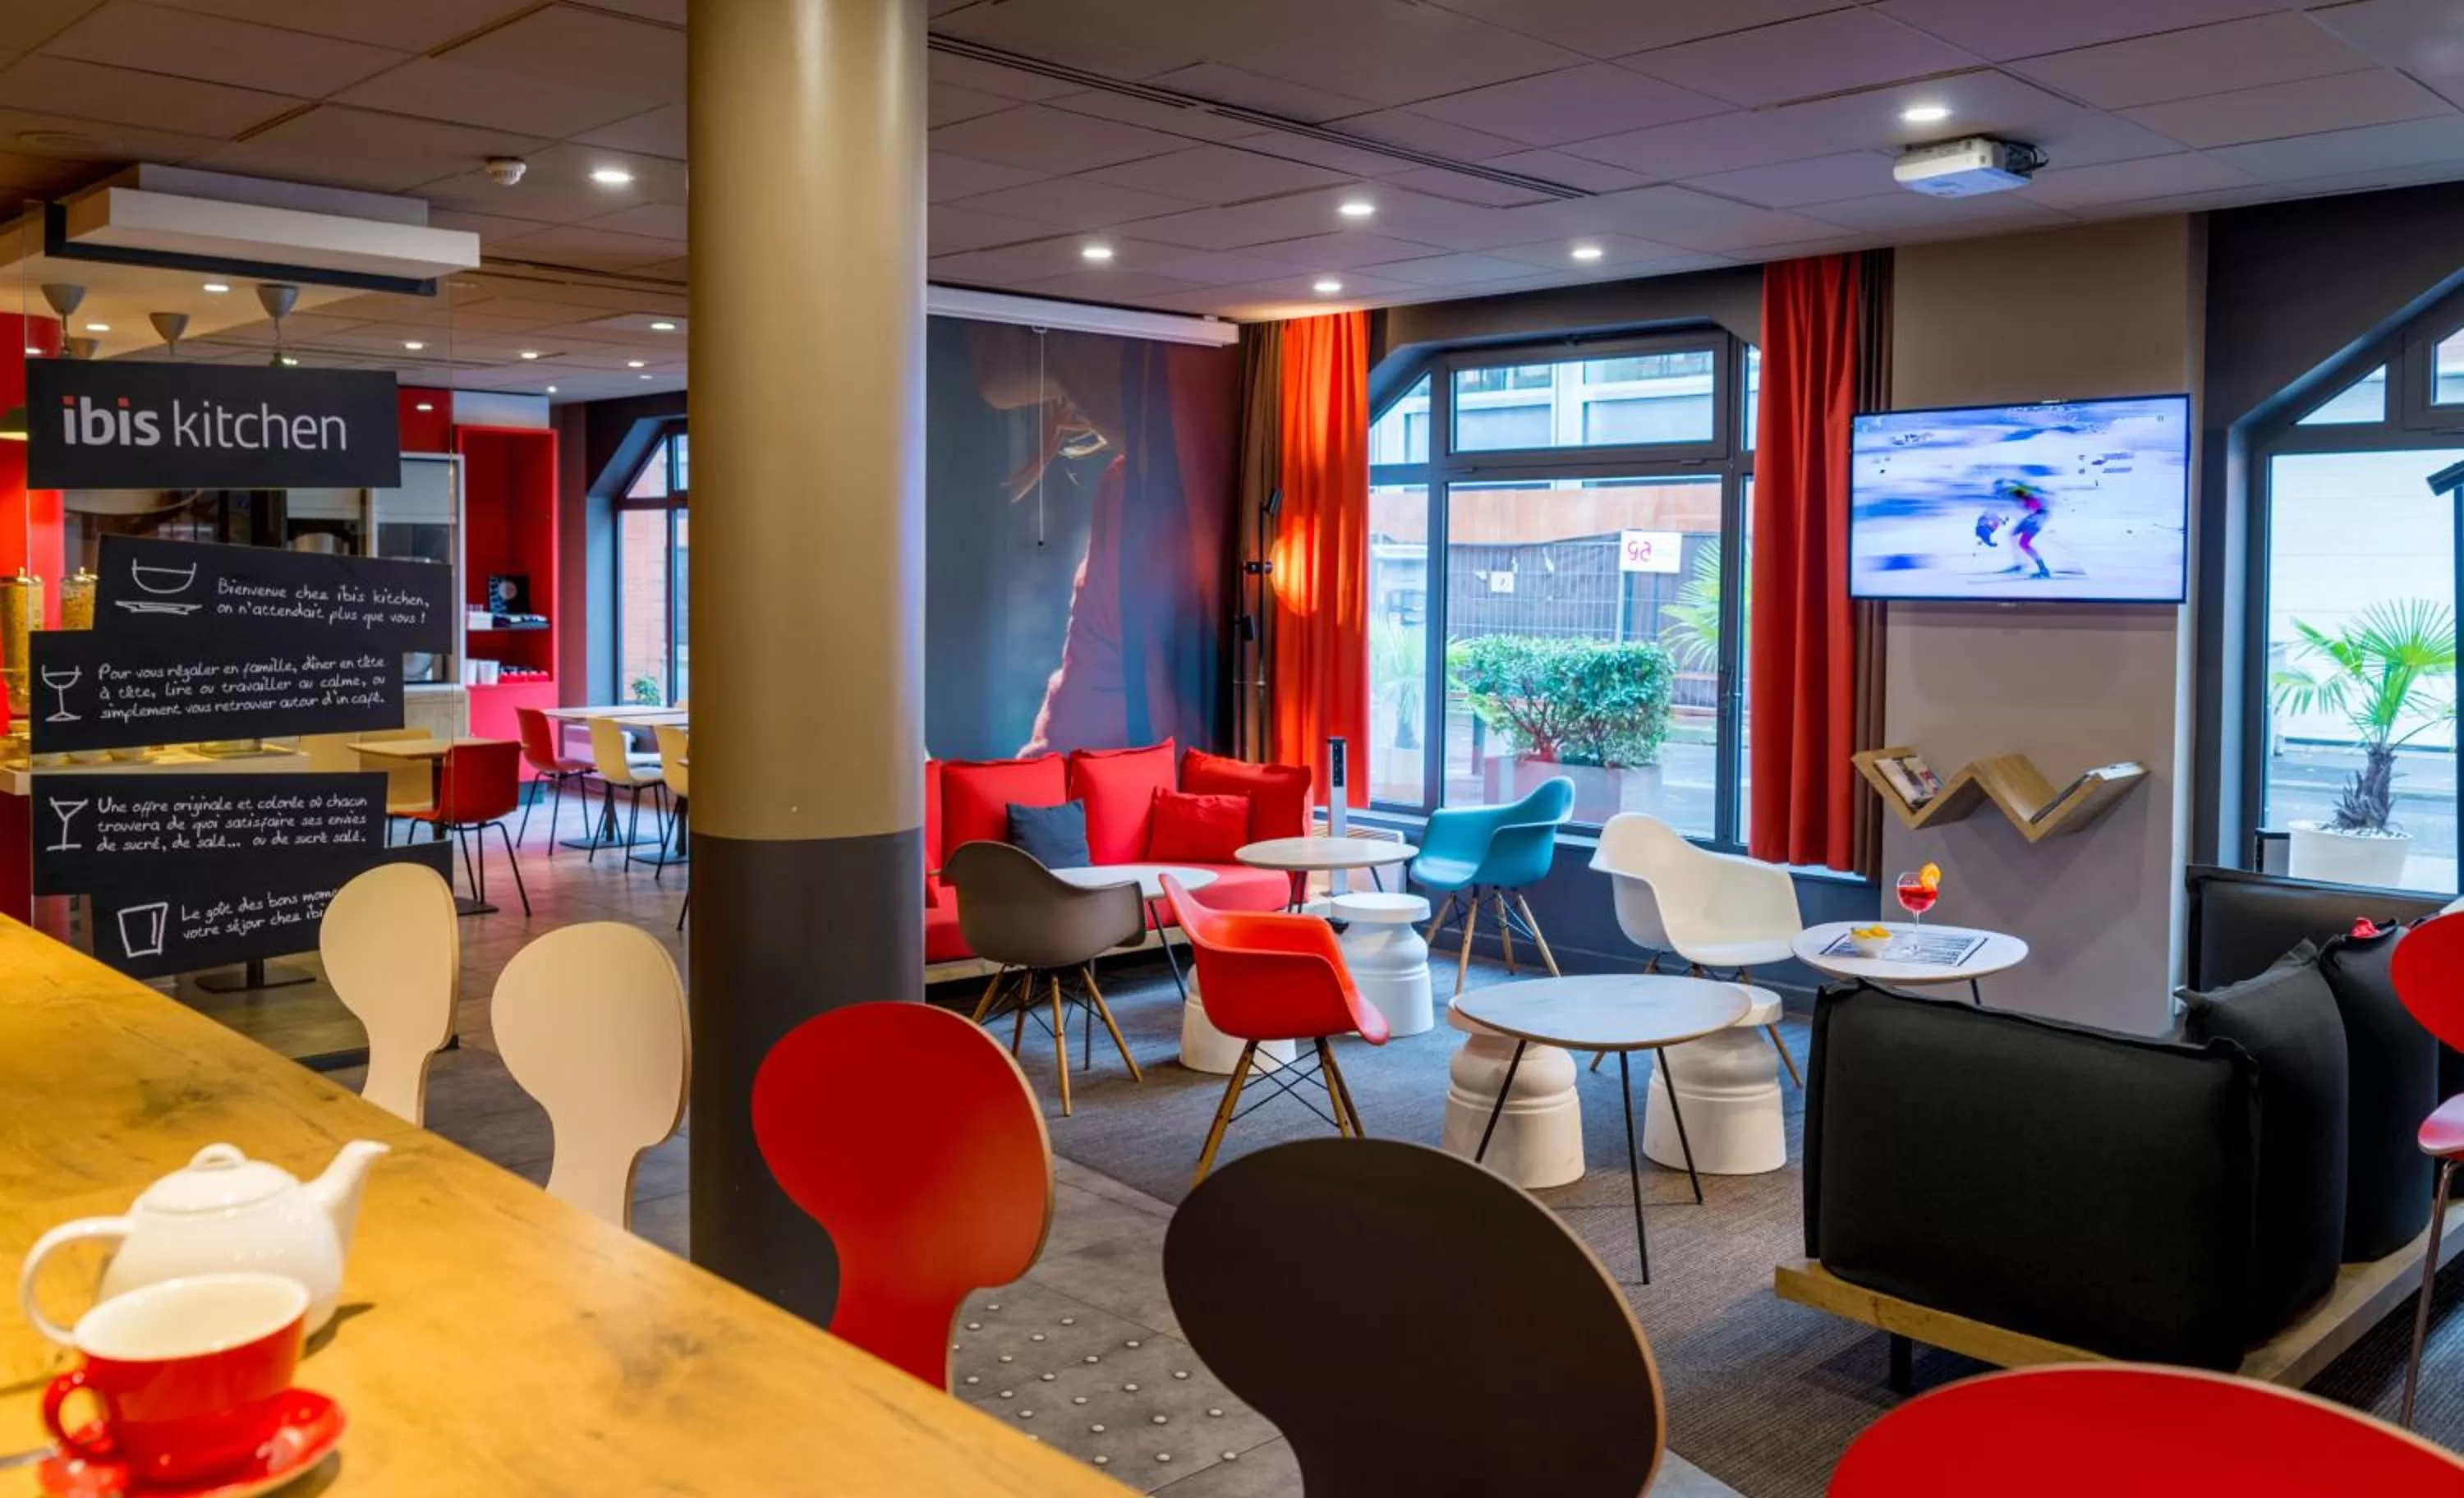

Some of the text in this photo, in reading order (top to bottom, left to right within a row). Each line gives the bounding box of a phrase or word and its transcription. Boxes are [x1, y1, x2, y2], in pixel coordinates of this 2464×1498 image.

[62, 395, 347, 451] ibis kitchen
[218, 577, 430, 608] Bienvenue chez ibis kitchen,
[217, 603, 233, 614] on
[238, 600, 325, 619] n'attendait
[329, 606, 358, 626] plus
[362, 612, 384, 630] que
[389, 613, 416, 624] vous
[98, 654, 386, 683] Pour vous régaler en famille, dîner en tête
[99, 686, 111, 700] à
[199, 684, 215, 695] ou
[221, 676, 292, 693] travailler
[298, 678, 314, 690] au
[319, 673, 366, 688] calme,
[372, 675, 386, 686] ou
[99, 702, 182, 724] simplement
[185, 703, 213, 715] vous
[214, 699, 277, 713] retrouver
[278, 696, 319, 710] autour
[350, 691, 386, 710] café.
[98, 796, 128, 814] Une
[131, 801, 168, 818] offre
[173, 795, 233, 817] originale
[237, 798, 255, 811] et
[257, 794, 306, 810] colorée
[326, 793, 368, 809] chacun
[97, 809, 367, 839] trouvera de quoi satisfaire ses envies
[96, 834, 117, 852] de
[122, 836, 167, 852] sucré,
[172, 833, 191, 849] de
[252, 835, 268, 847] ou
[270, 829, 290, 846] de
[294, 831, 329, 846] sucré
[332, 829, 366, 843] salé.
[181, 904, 201, 922] Le
[205, 900, 234, 925] goût
[237, 896, 264, 913] des
[266, 890, 299, 908] bons
[182, 902, 324, 940] votre séjour chez ibi
